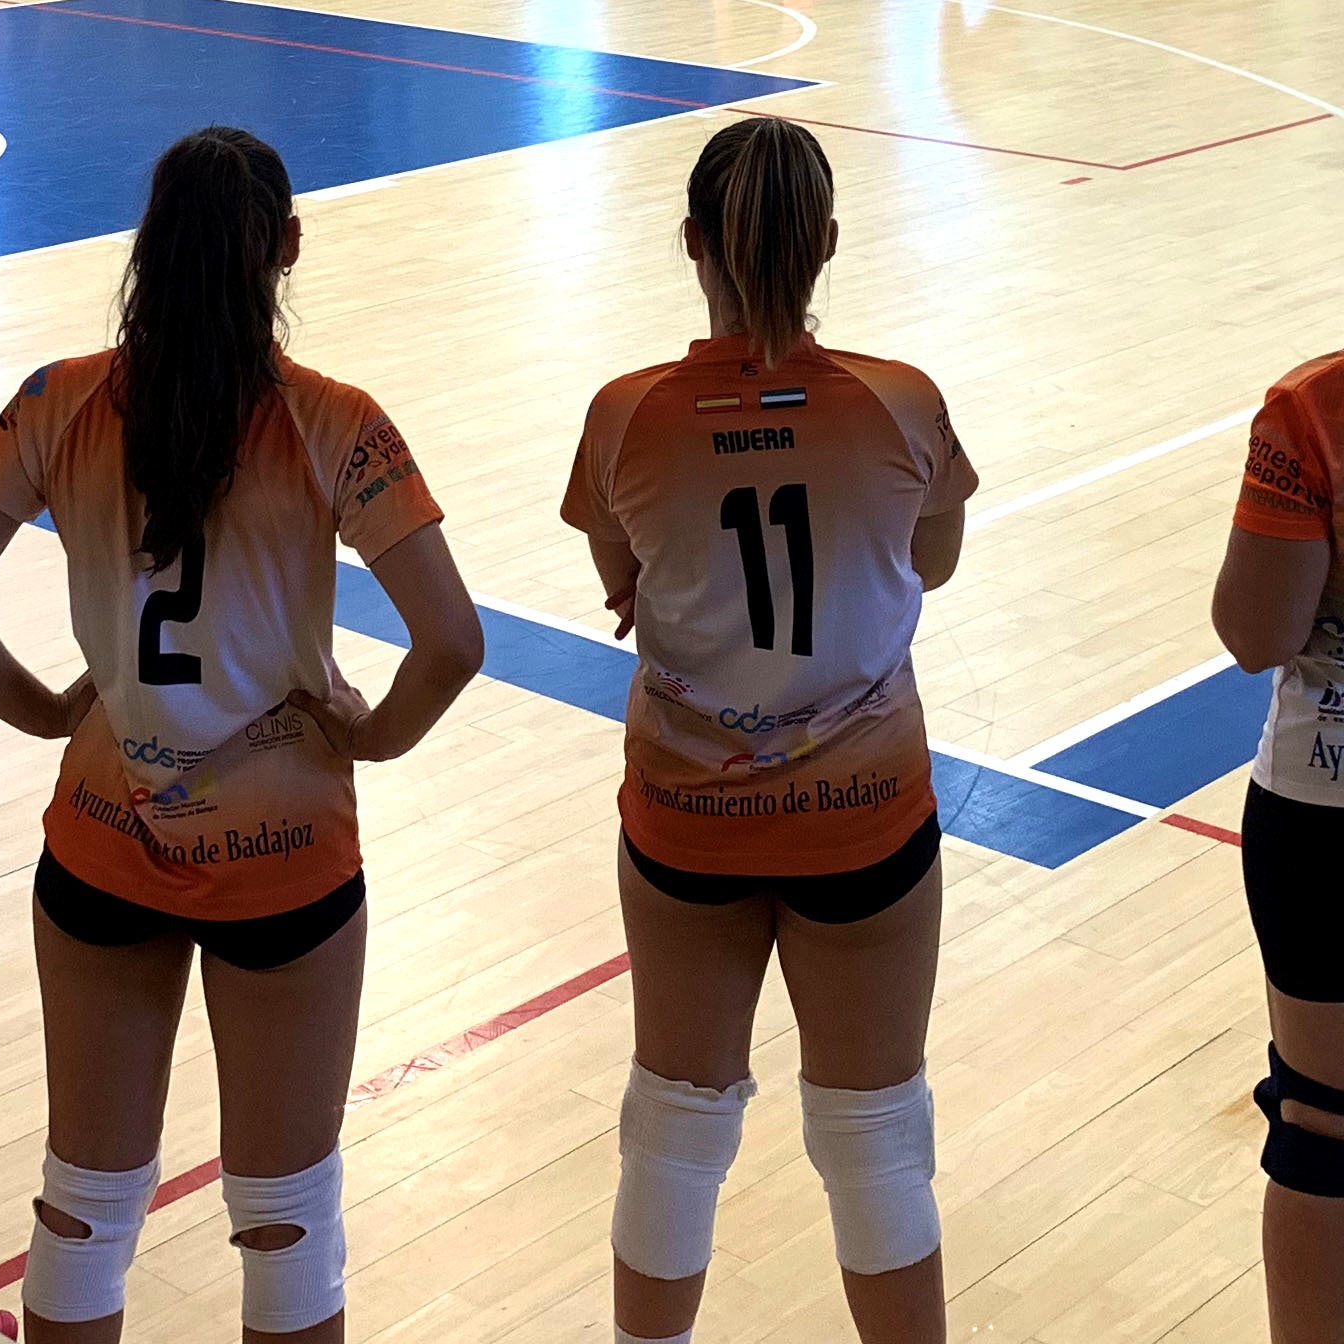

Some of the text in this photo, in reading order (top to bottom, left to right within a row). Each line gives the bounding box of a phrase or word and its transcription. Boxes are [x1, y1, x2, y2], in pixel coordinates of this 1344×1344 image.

[713, 427, 795, 455] RIVERA
[719, 484, 815, 657] 11
[139, 536, 203, 686] 2
[246, 714, 304, 742] CLINIS
[719, 704, 777, 734] cds
[123, 736, 177, 768] cds
[782, 782, 810, 815] de
[816, 771, 901, 814] Badajoz
[192, 835, 220, 865] de
[225, 819, 314, 862] Badajoz
